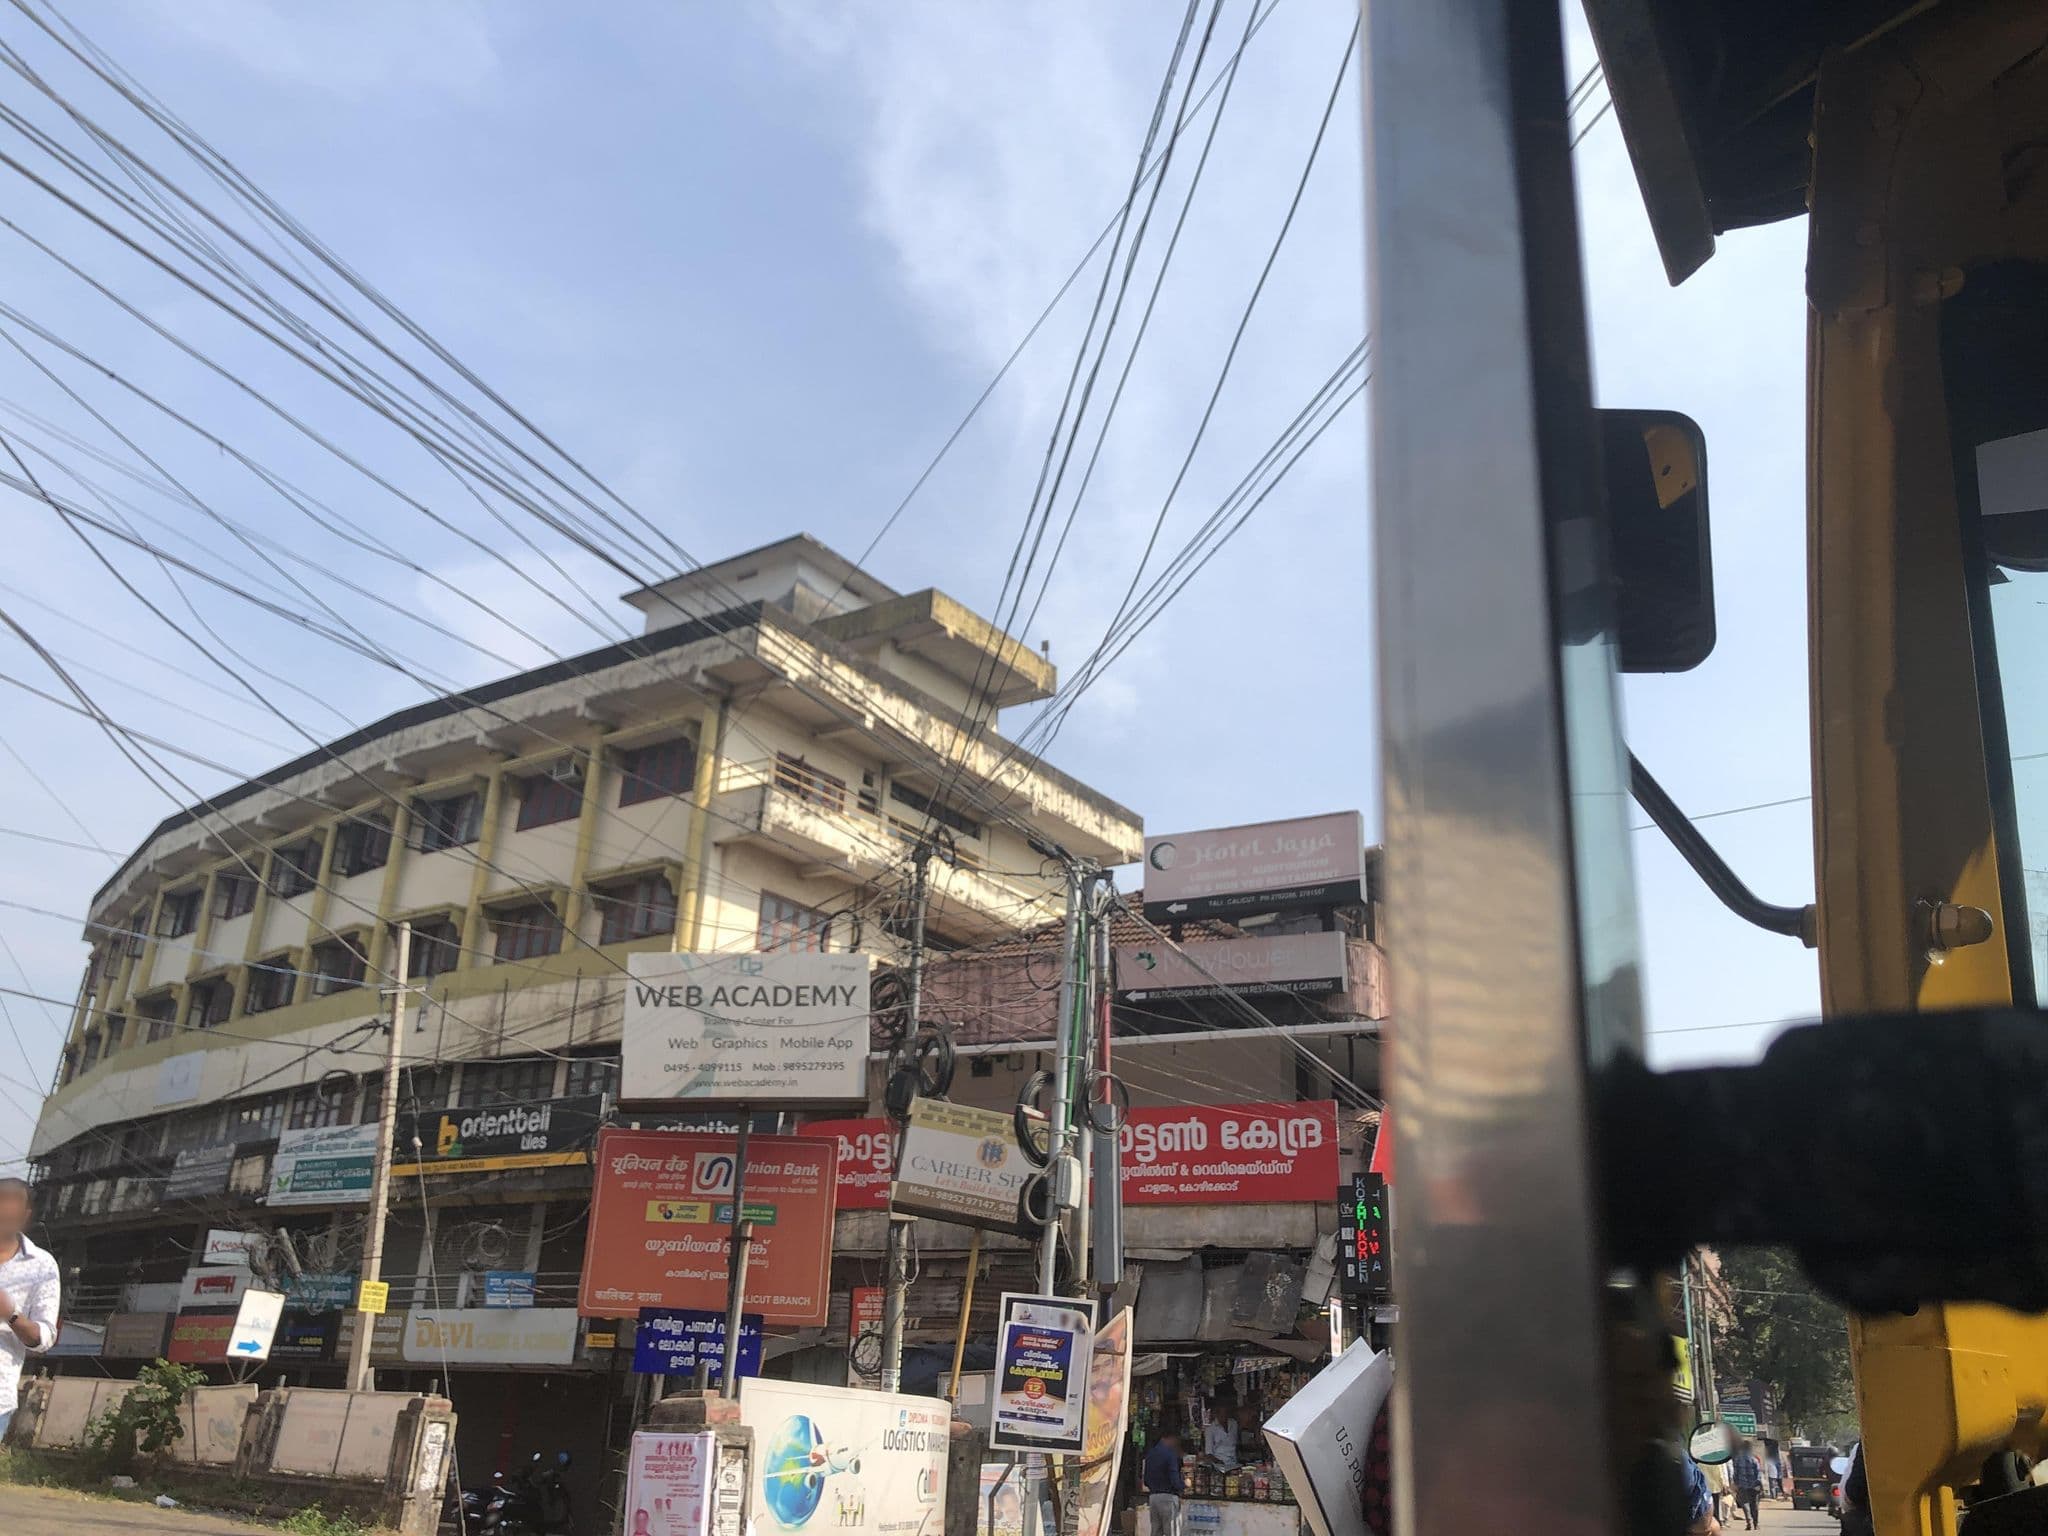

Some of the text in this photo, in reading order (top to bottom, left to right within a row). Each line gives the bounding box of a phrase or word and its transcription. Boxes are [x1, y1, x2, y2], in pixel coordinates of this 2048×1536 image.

[1184, 832, 1335, 868] Hotel Jaya
[1299, 981, 1333, 992] CATERING
[635, 984, 857, 1009] WEB ACADEMY
[778, 1016, 794, 1025] For
[668, 1036, 853, 1051] Web Graphics Mobile App
[664, 1063, 690, 1073] 0495
[695, 1078, 798, 1089] www.webacademy.in
[459, 1103, 552, 1140] orientbell
[611, 1152, 660, 1175] यूनियन
[783, 1162, 819, 1177] Bank
[1180, 1164, 1188, 1176] &
[911, 1154, 1025, 1189] CAREER SP
[742, 1295, 811, 1306] LICUT BRANCH
[415, 1321, 475, 1349] DEVI
[882, 1428, 926, 1452] LOGISTICS
